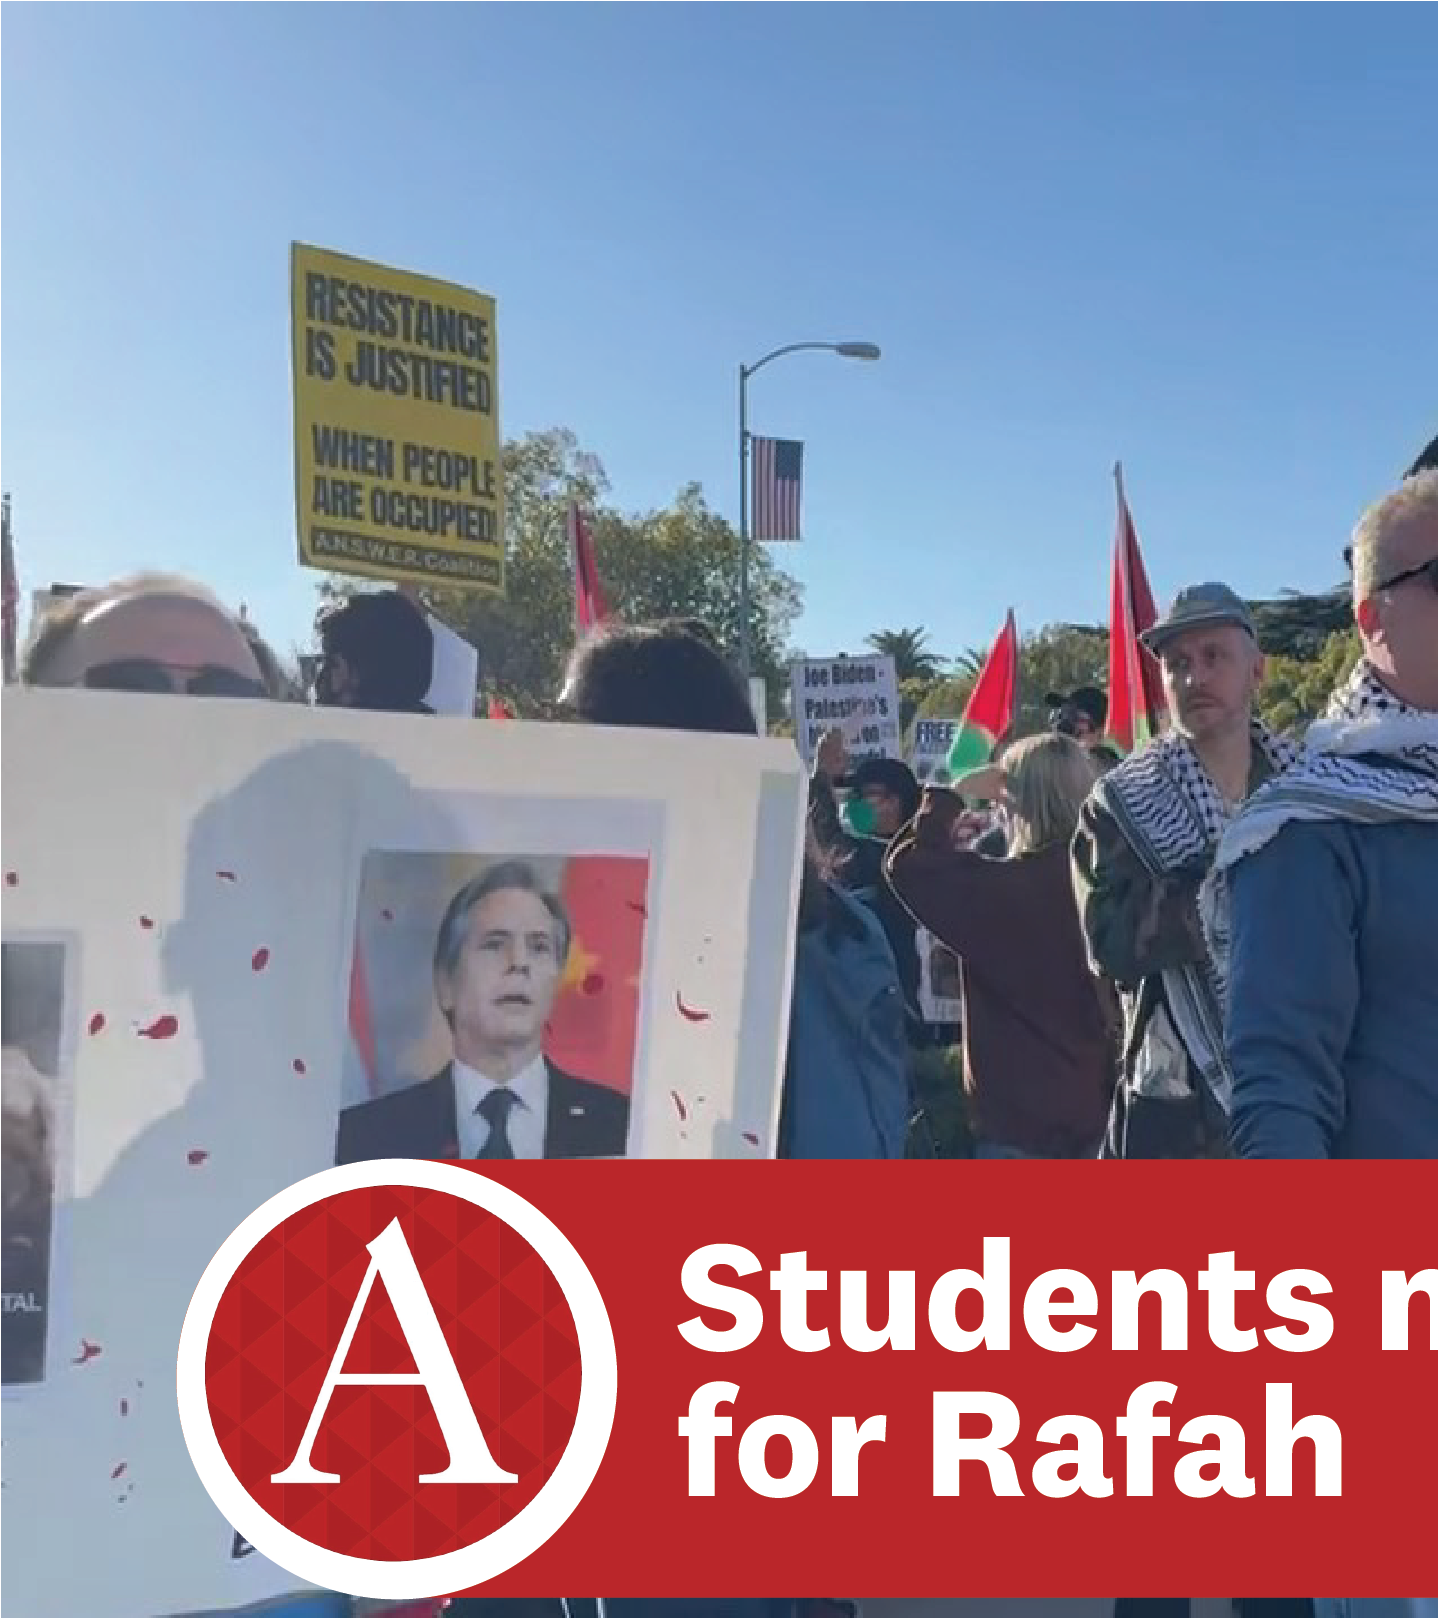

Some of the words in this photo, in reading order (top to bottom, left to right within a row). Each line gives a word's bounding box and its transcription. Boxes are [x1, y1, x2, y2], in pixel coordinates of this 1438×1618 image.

[306, 271, 490, 364] RESISTANCE
[306, 326, 336, 381] IS
[345, 340, 491, 416] JUSTIFIED
[312, 422, 395, 481] WHEN
[402, 441, 496, 500] PEOPLE
[312, 474, 366, 521] ARE
[424, 552, 500, 581] Coalition
[804, 665, 829, 688] Joe
[831, 662, 876, 685] Biden
